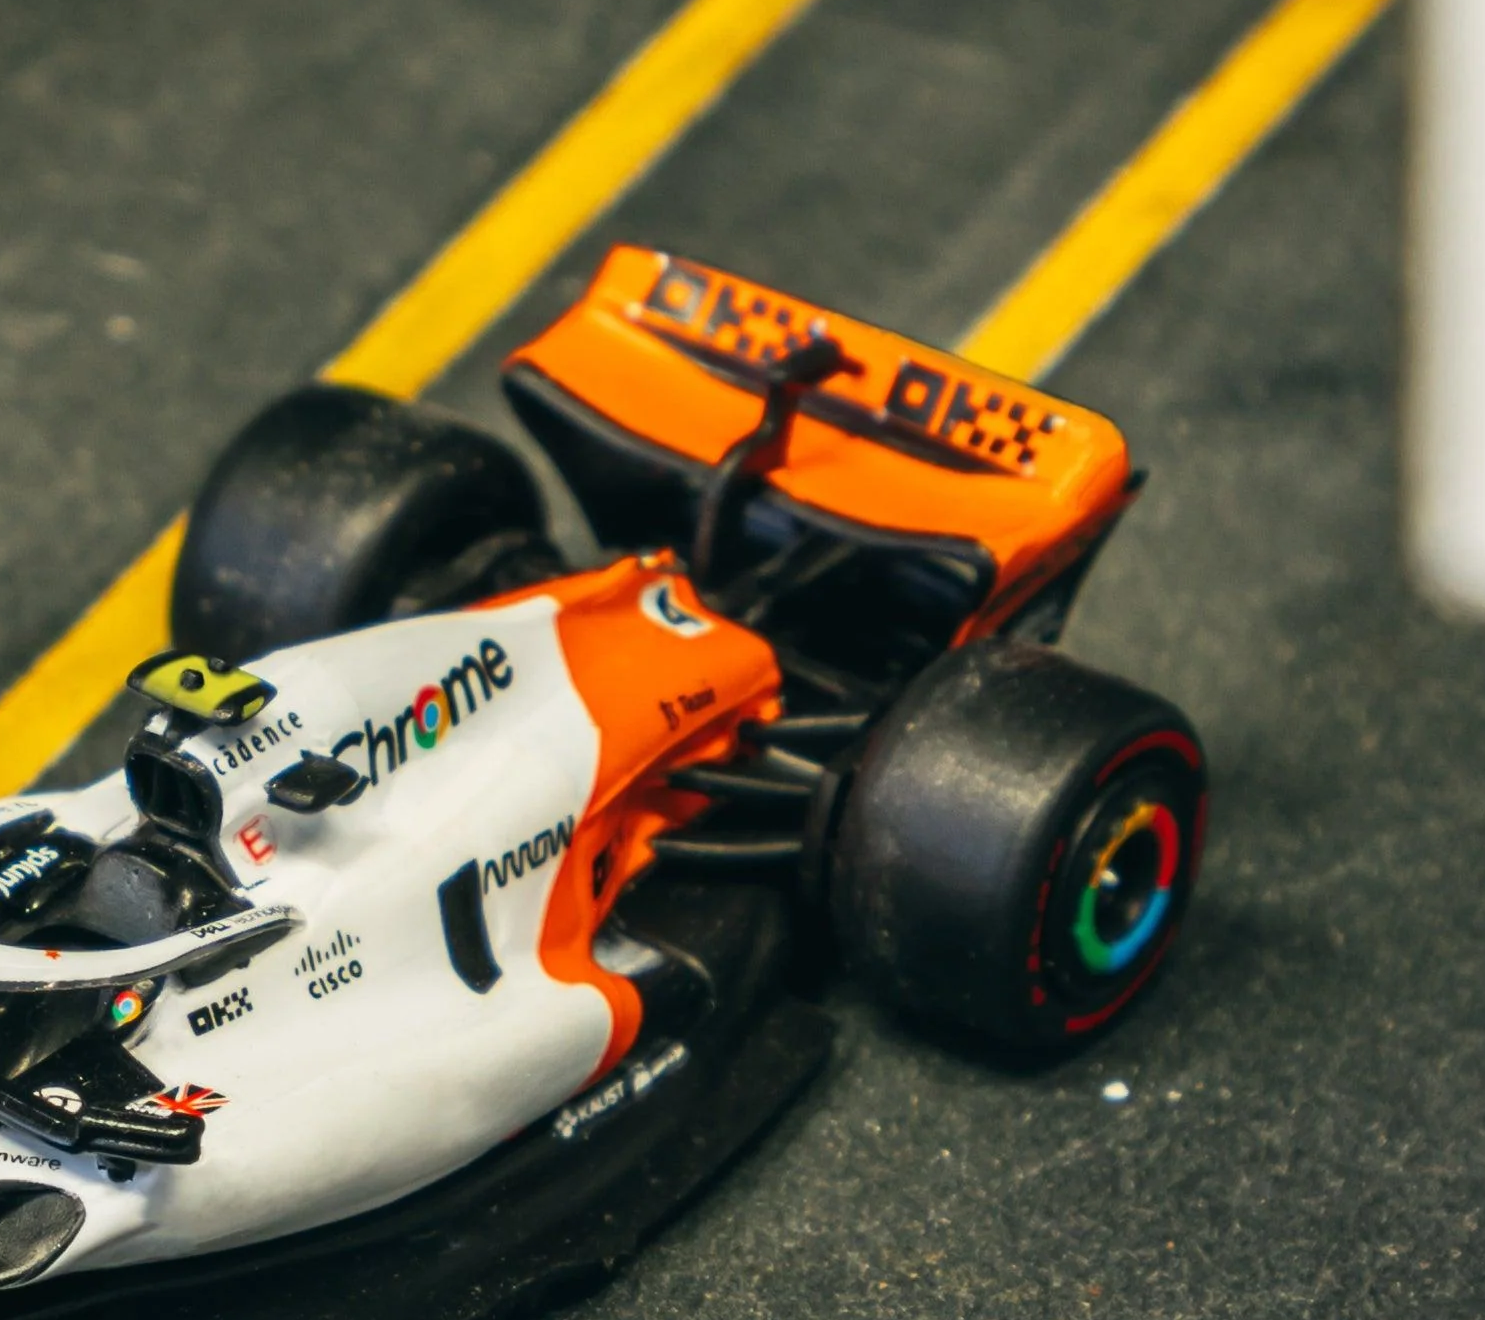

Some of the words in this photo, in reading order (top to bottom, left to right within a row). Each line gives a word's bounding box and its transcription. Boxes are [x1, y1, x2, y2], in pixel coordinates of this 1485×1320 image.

[644, 266, 828, 365] OKX
[885, 360, 1060, 464] OKX
[186, 986, 254, 1037] OKX
